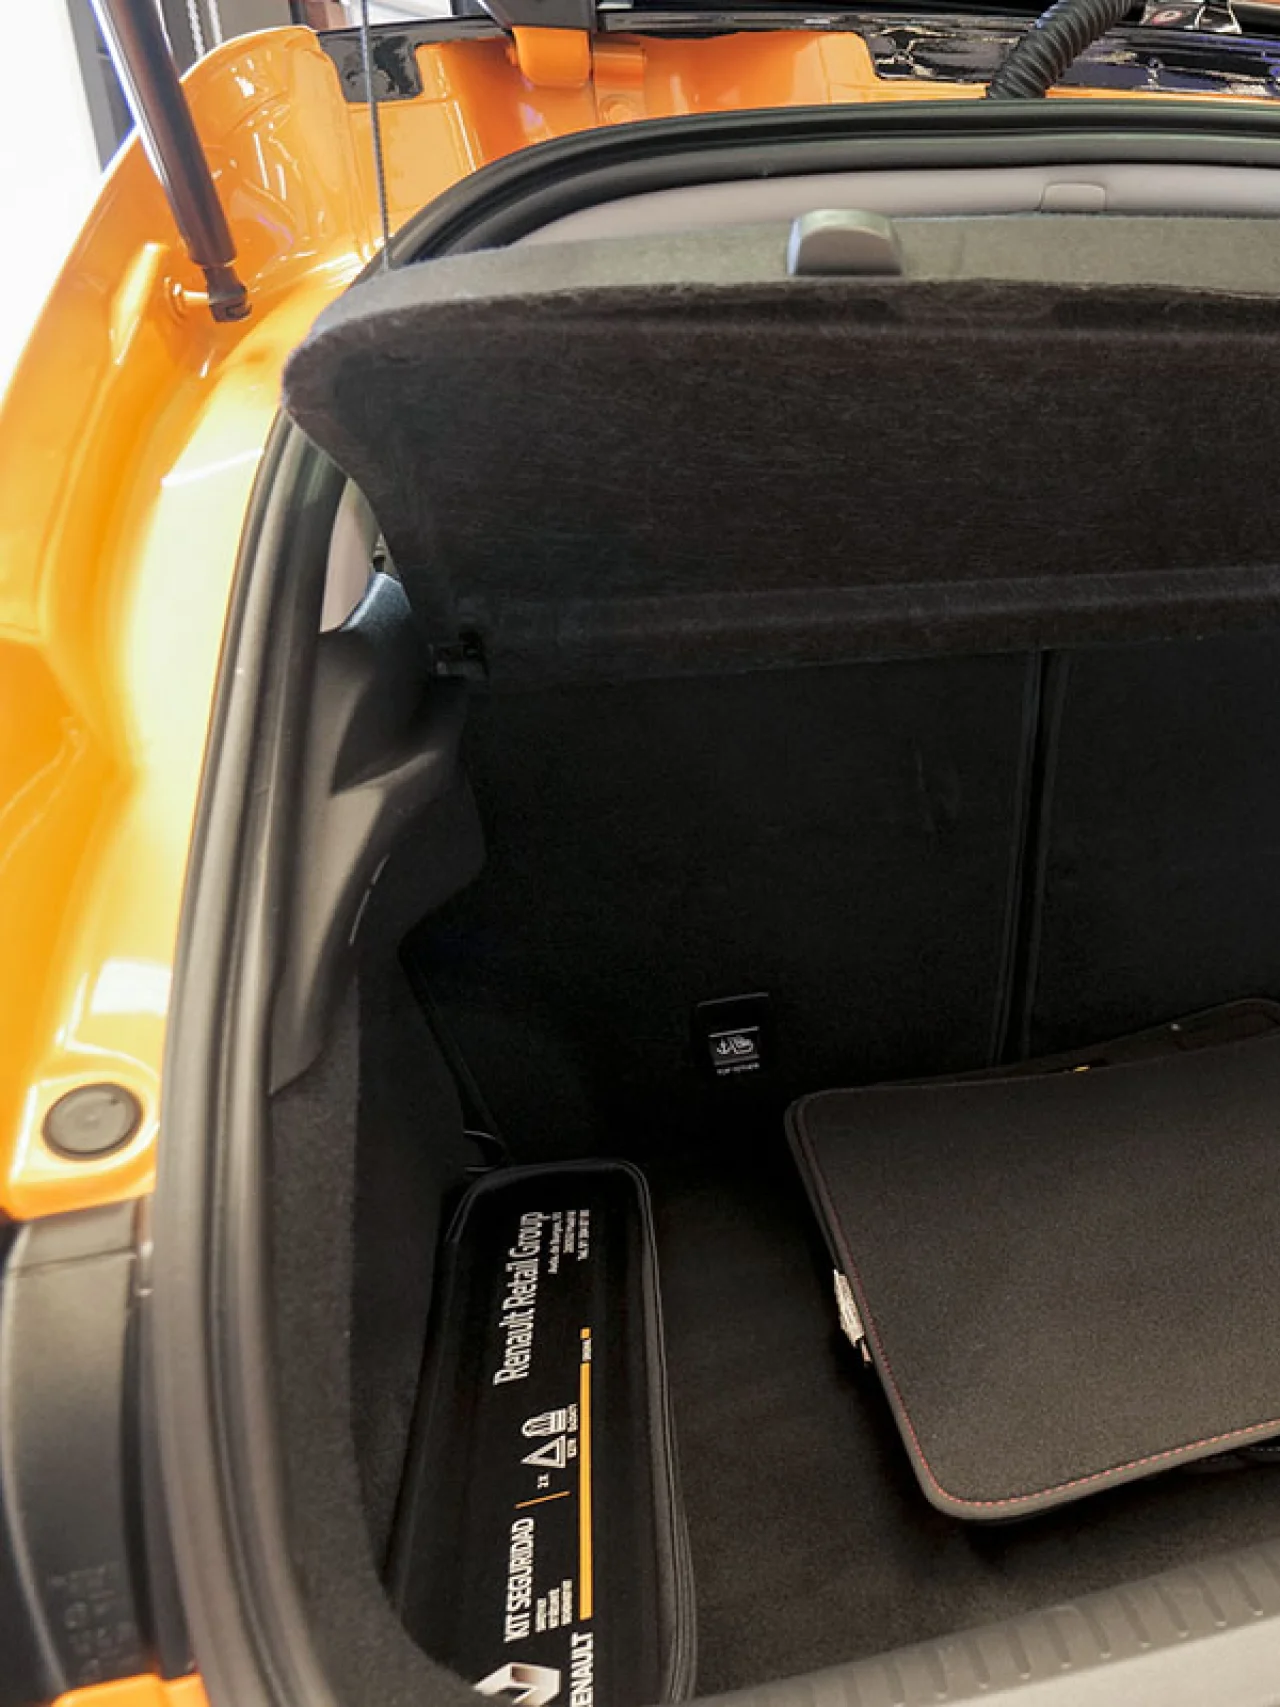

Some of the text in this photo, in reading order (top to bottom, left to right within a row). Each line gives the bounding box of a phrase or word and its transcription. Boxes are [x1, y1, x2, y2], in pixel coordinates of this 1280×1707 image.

[493, 1212, 551, 1385] Renault Retail Group
[504, 1517, 534, 1643] KIT SEGURIDAD
[570, 1632, 594, 1707] ENAULT
